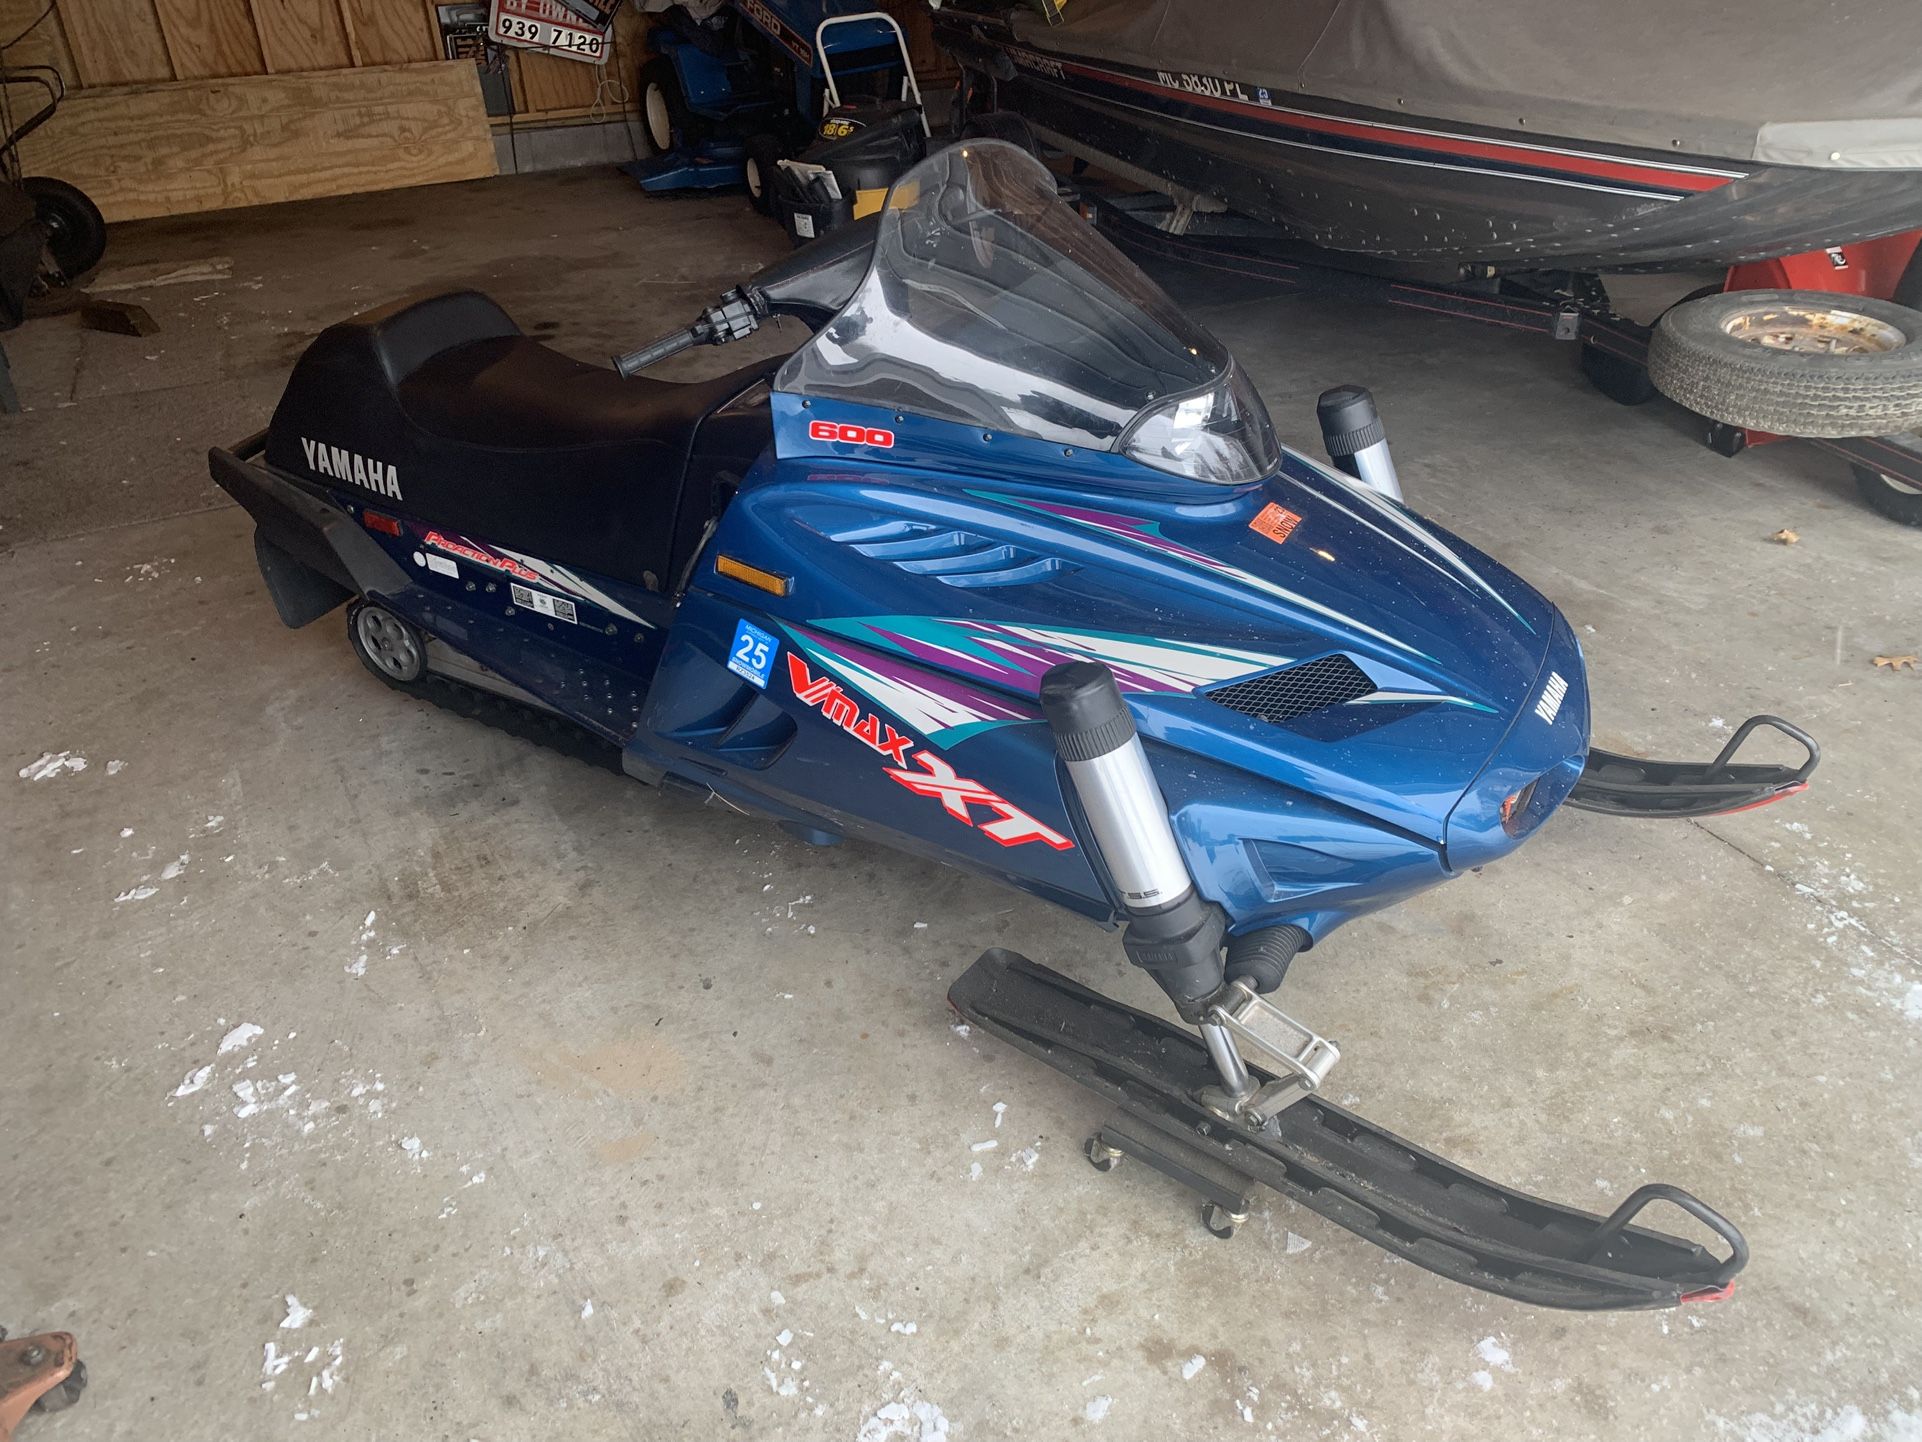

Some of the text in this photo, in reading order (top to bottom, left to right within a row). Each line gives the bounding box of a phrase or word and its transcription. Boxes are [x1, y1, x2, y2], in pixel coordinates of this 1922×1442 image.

[745, 0, 781, 35] FORD
[501, 18, 600, 54] 939 7120
[809, 420, 895, 449] 600
[301, 436, 403, 501] YAMAHA
[499, 557, 540, 582] PLUS
[744, 624, 772, 642] MICHIGAN
[735, 634, 770, 671] 25
[1534, 671, 1569, 726] YAMAHA
[882, 750, 1076, 851] XT
